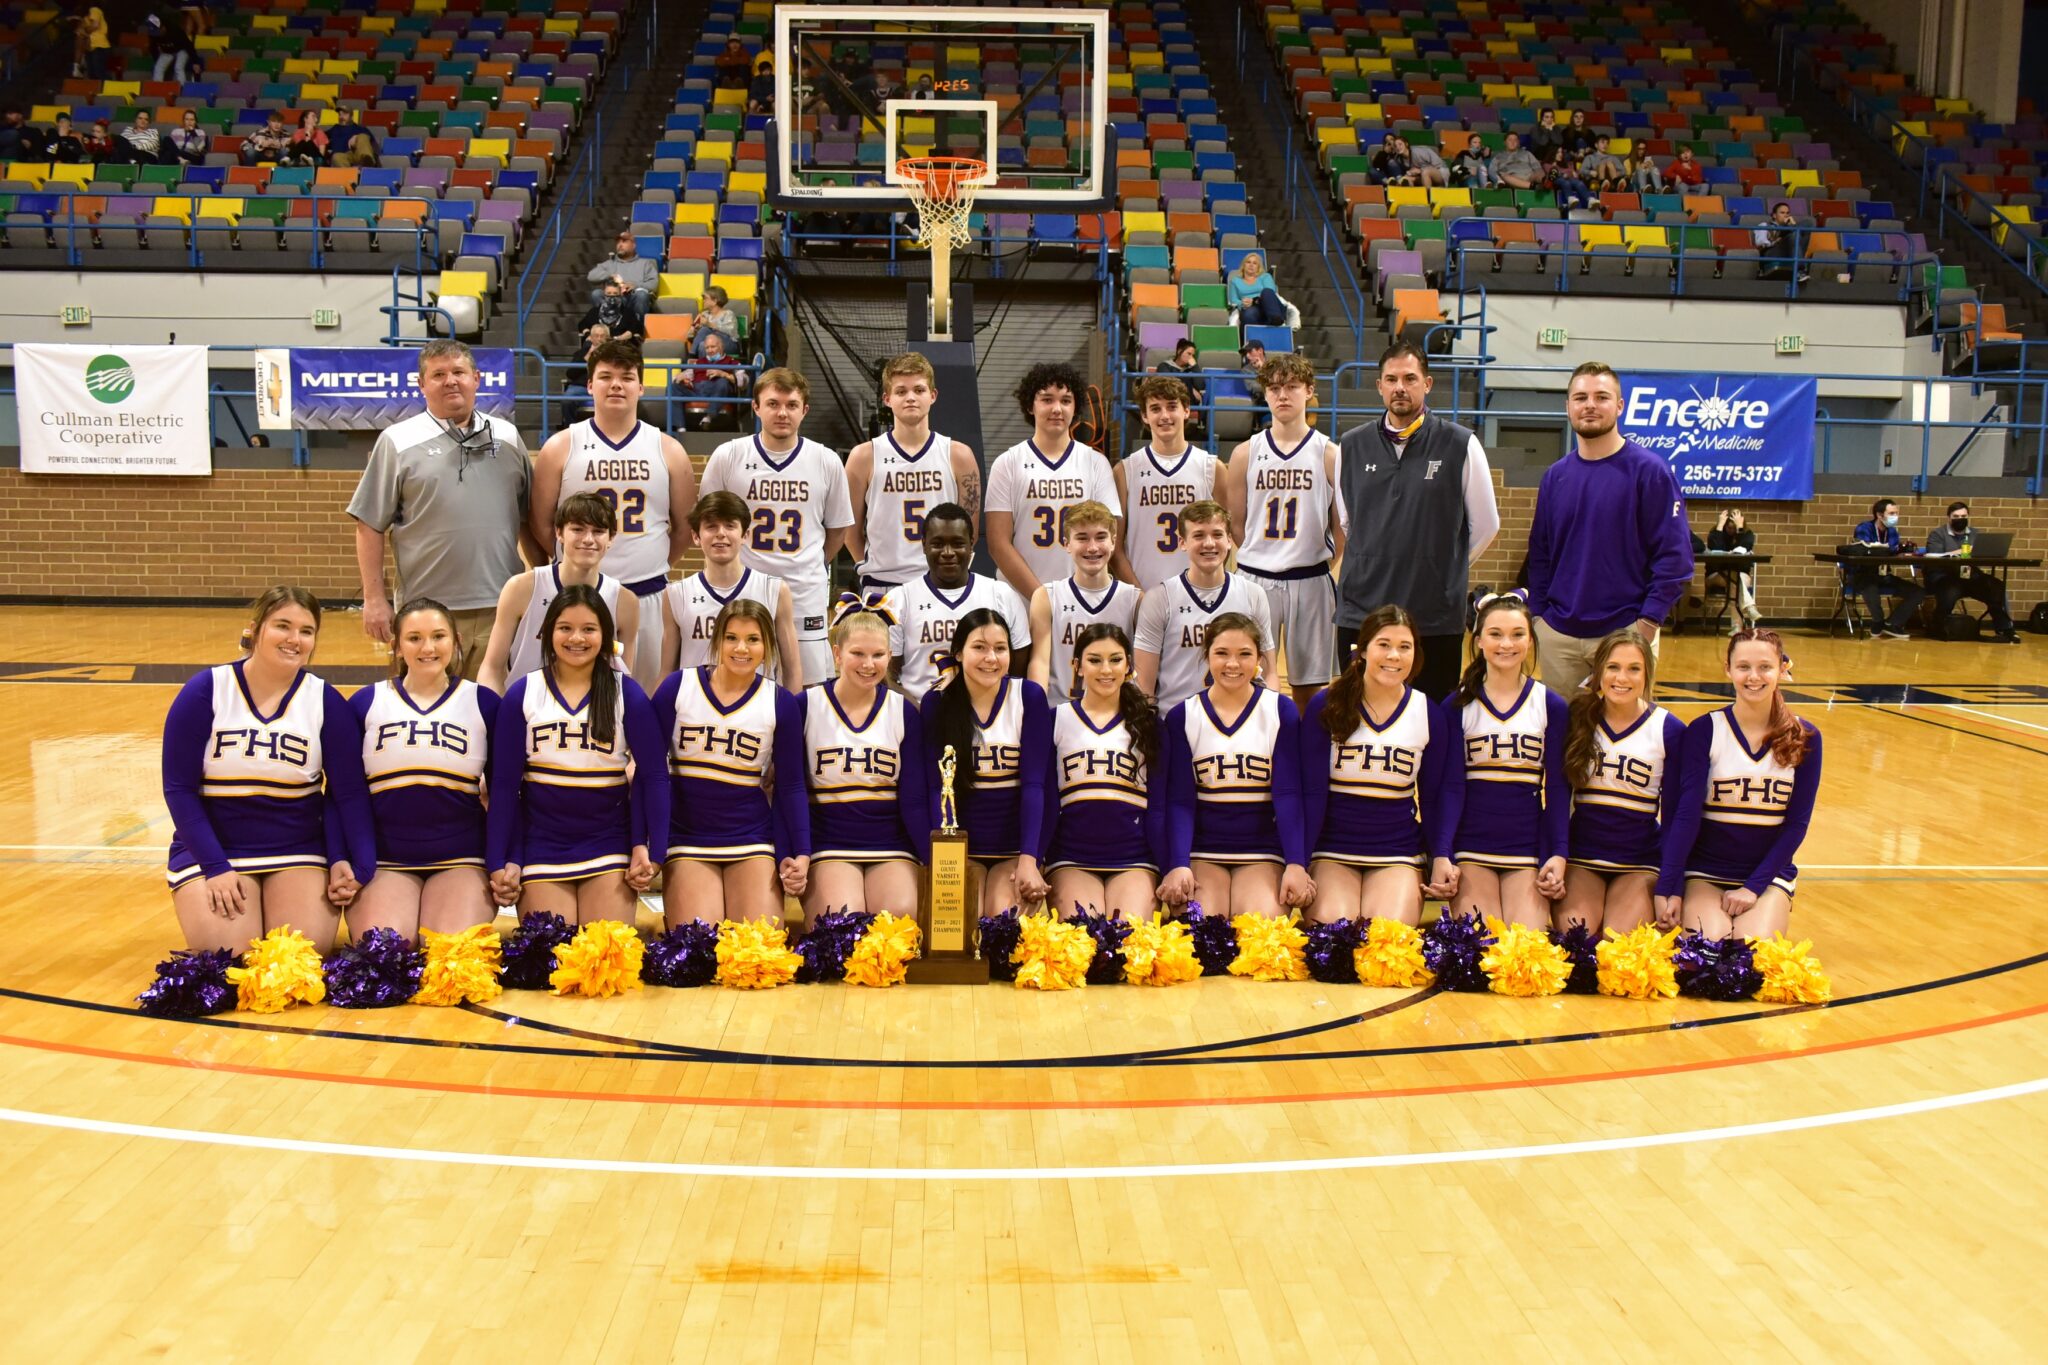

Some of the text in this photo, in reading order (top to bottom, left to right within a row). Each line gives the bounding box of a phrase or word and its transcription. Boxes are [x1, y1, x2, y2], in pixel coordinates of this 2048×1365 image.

[65, 307, 84, 322] EXIT
[316, 310, 334, 324] EXIT
[1545, 329, 1564, 343] EXIT
[1783, 336, 1800, 350] EXIT
[301, 372, 399, 388] MITCH
[40, 411, 184, 428] Cullman Electric
[59, 429, 163, 447] Cooperative
[1698, 435, 1765, 450] Medicine
[48, 456, 80, 464] POWERFUL
[126, 457, 154, 465] BRIGHTER
[585, 459, 650, 481] AGGIES
[1424, 460, 1442, 480] F
[883, 470, 943, 493] AGGIES
[1255, 469, 1313, 490] AGGIES
[1684, 465, 1783, 481] 256-775-3737
[747, 479, 809, 502] AGGIES
[1027, 478, 1084, 499] AGGIES
[1139, 484, 1196, 507] AGGIES
[903, 499, 926, 543] 5
[1263, 496, 1299, 541] 11
[1672, 501, 1681, 518] F
[751, 507, 802, 553] 23
[1156, 511, 1180, 553] 3
[920, 619, 961, 643] AGG
[211, 727, 309, 768] FHS
[374, 719, 470, 756] FHS
[531, 721, 615, 755] FH
[678, 725, 762, 762] FHS
[1465, 732, 1543, 762] FHS
[814, 746, 897, 778] FHS
[972, 744, 1021, 773] HS
[1062, 748, 1137, 784] FHS
[1193, 753, 1271, 784] FHS
[1334, 744, 1415, 776] FHS
[1595, 751, 1653, 789] HS
[1712, 777, 1793, 805] FHS
